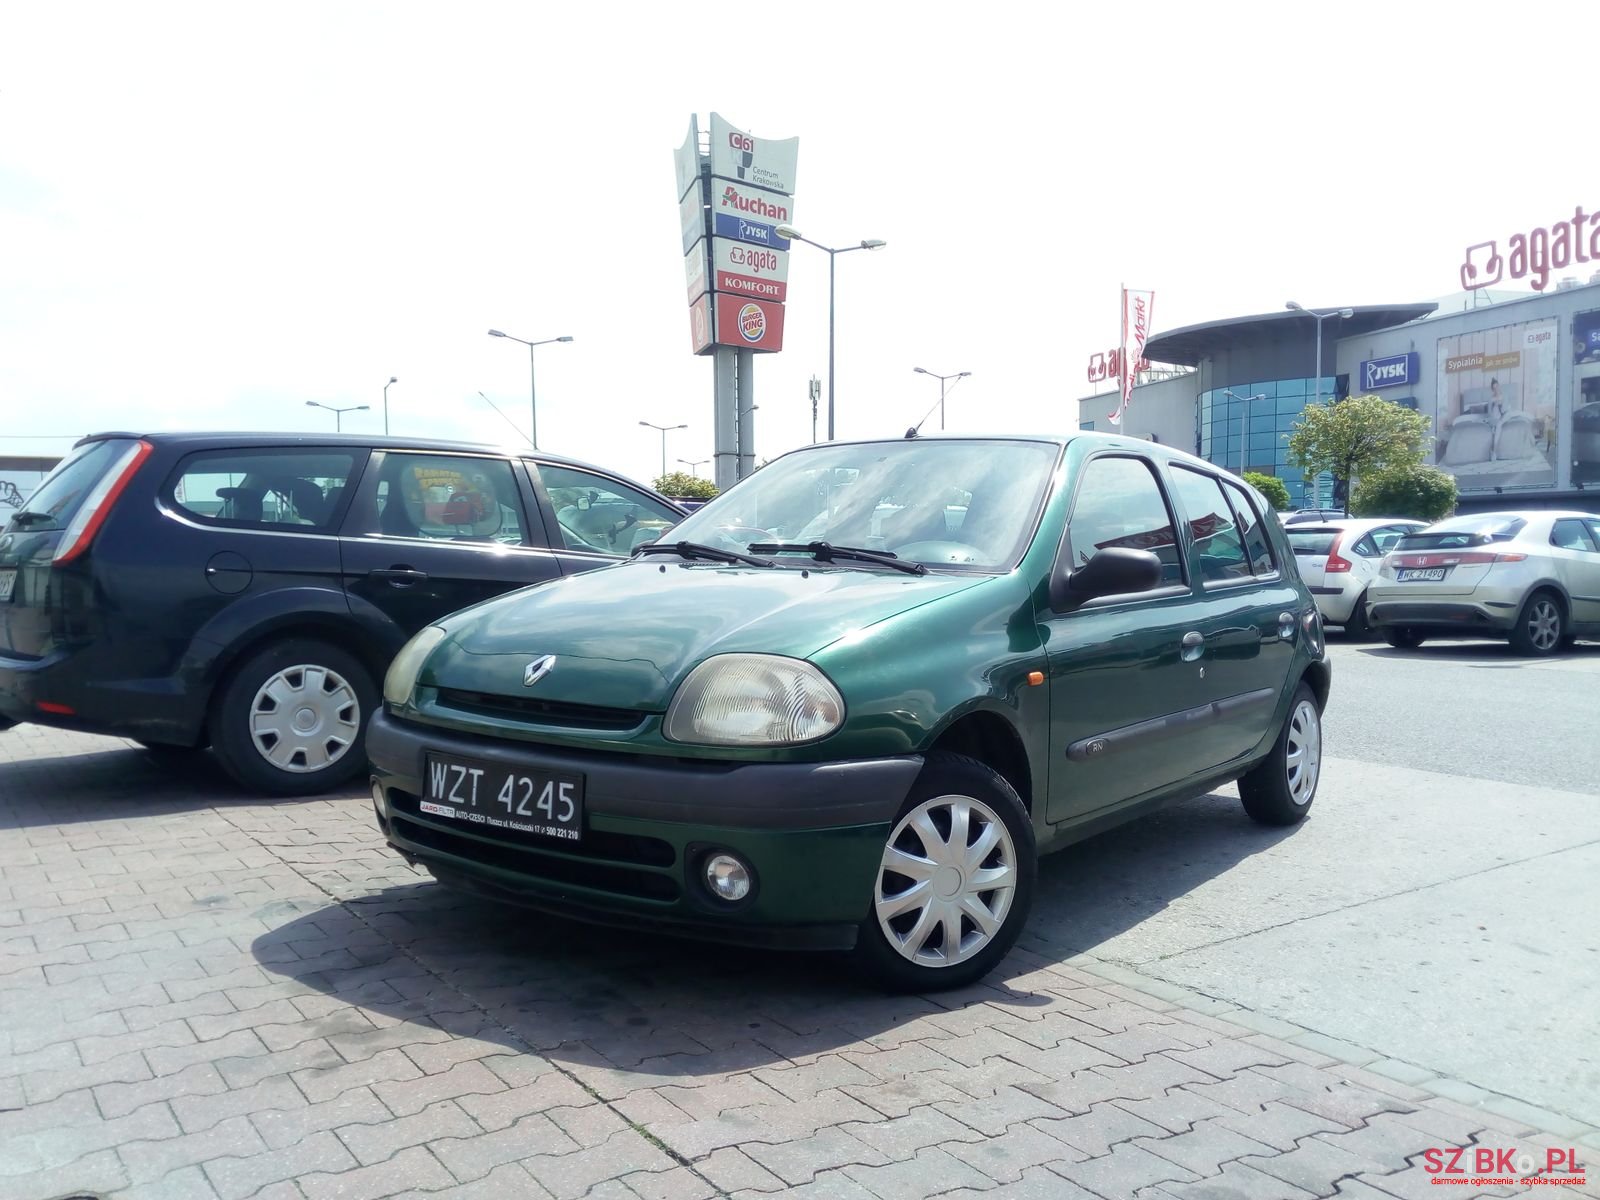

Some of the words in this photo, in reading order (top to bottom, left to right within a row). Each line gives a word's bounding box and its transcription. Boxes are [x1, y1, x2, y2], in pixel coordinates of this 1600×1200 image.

[753, 166, 779, 179] Centrum
[753, 174, 784, 190] Krakowska
[722, 186, 787, 221] Auchan
[745, 227, 767, 239] JYSK
[747, 249, 777, 273] agata
[725, 277, 780, 295] KOMFORT
[742, 312, 762, 323] BURGER
[743, 319, 763, 333] KING
[1375, 363, 1405, 380] JYSK
[1417, 569, 1442, 578] 21490
[431, 761, 484, 806] WZT
[498, 774, 574, 822] 4245
[546, 826, 556, 836] 500
[557, 828, 567, 837] 221
